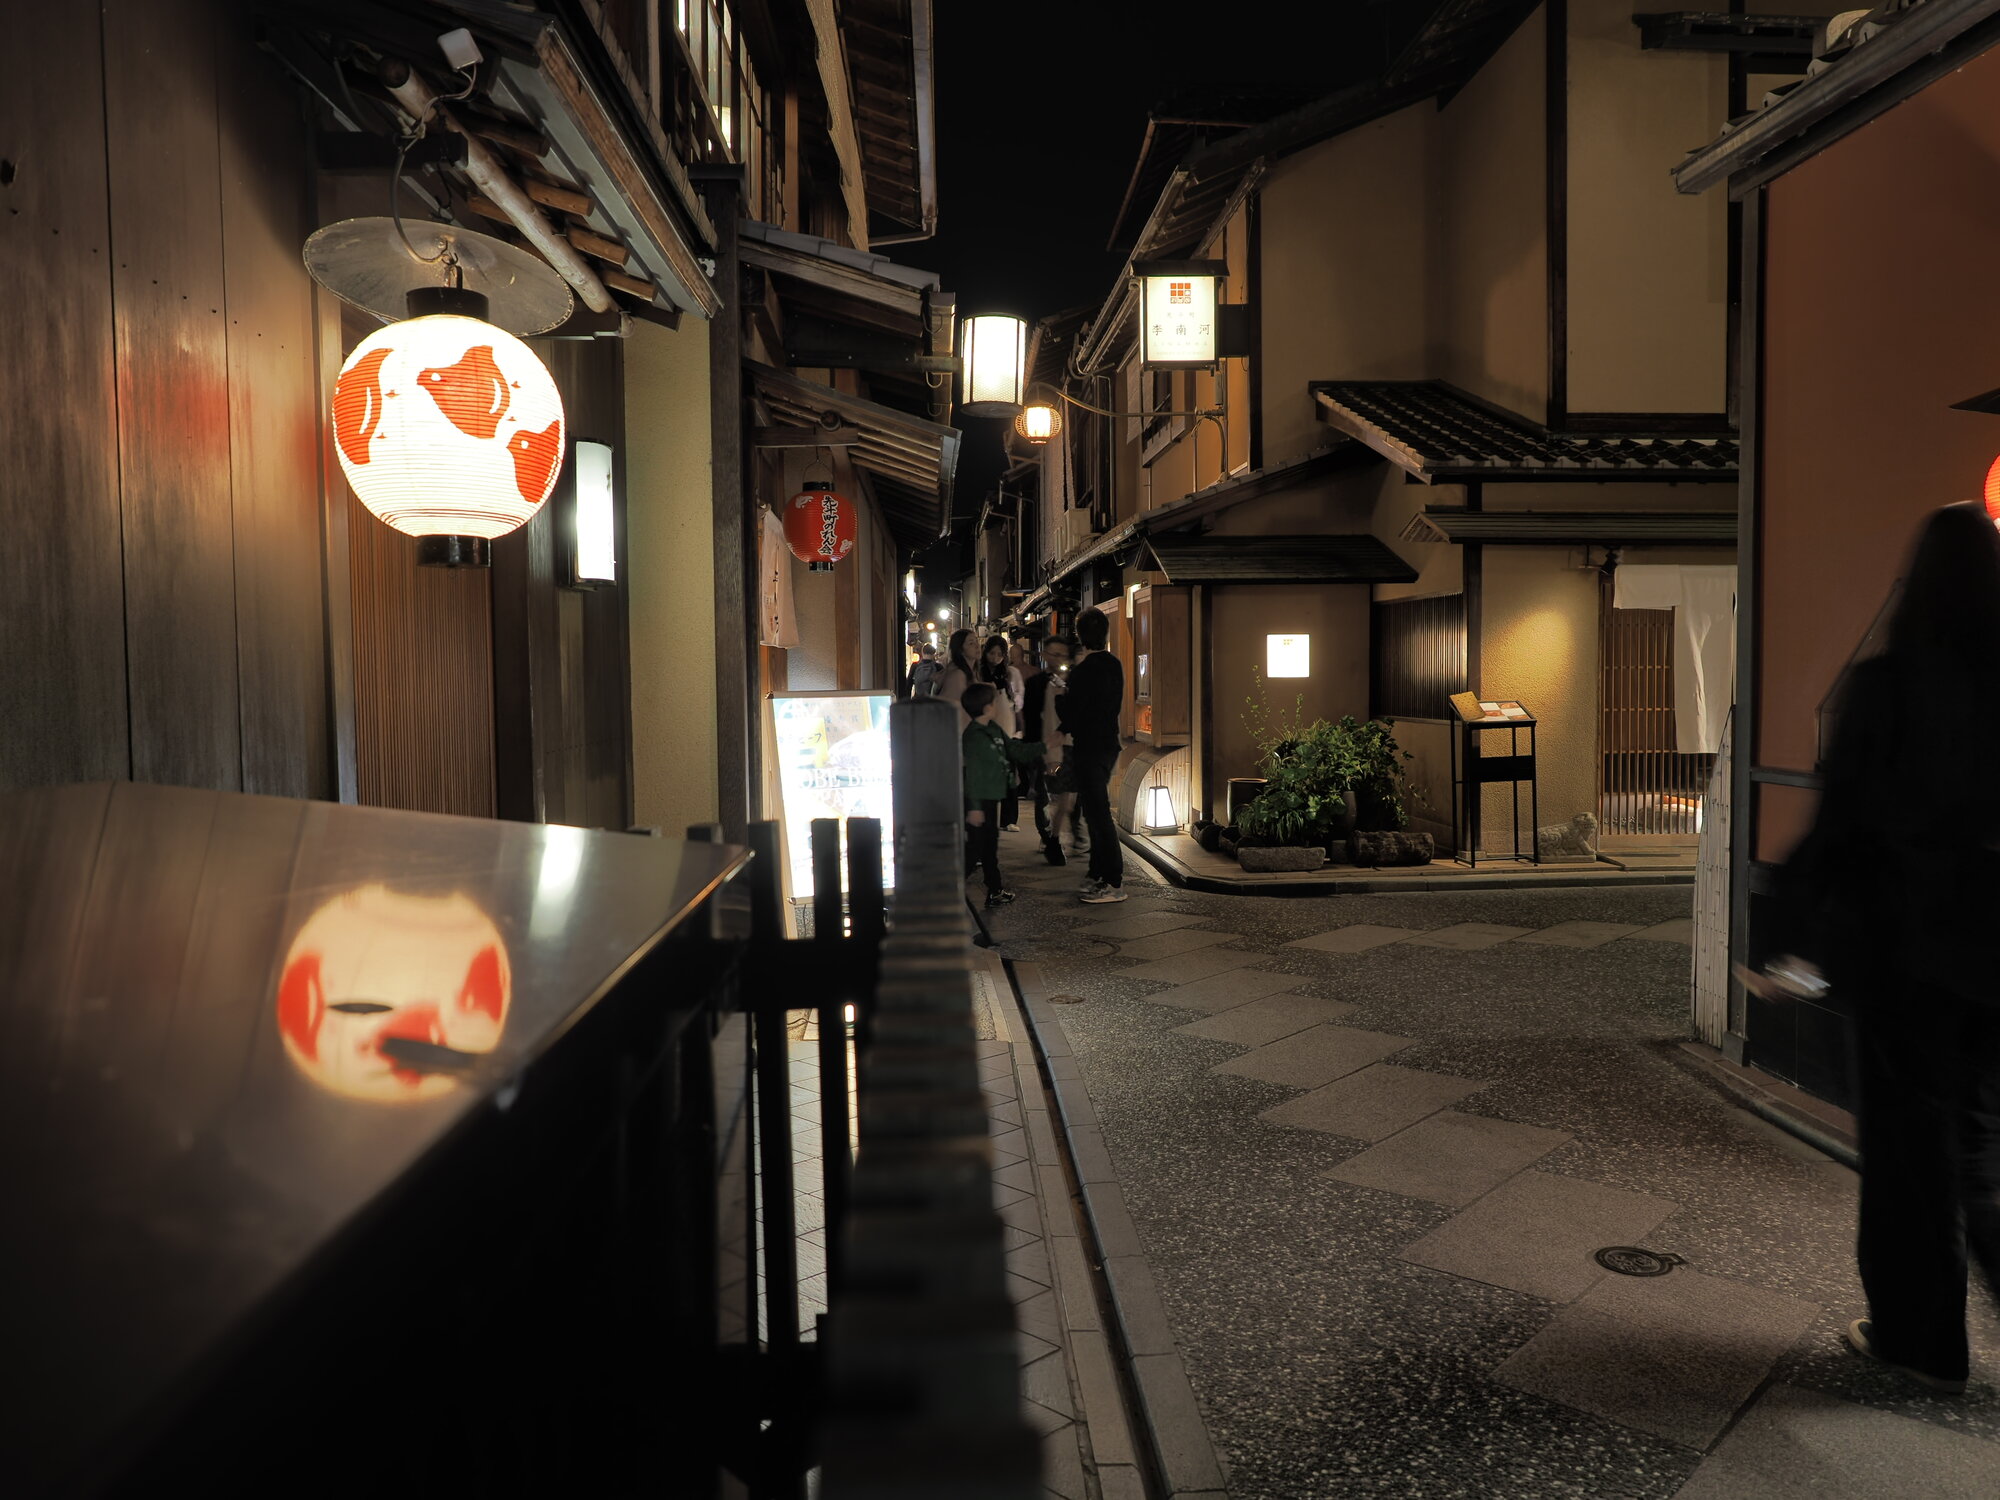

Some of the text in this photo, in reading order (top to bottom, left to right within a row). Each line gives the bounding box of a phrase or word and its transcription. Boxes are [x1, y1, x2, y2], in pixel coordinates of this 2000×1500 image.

[1152, 324, 1210, 336] 李南河
[819, 495, 838, 555] 先斗町のれん会
